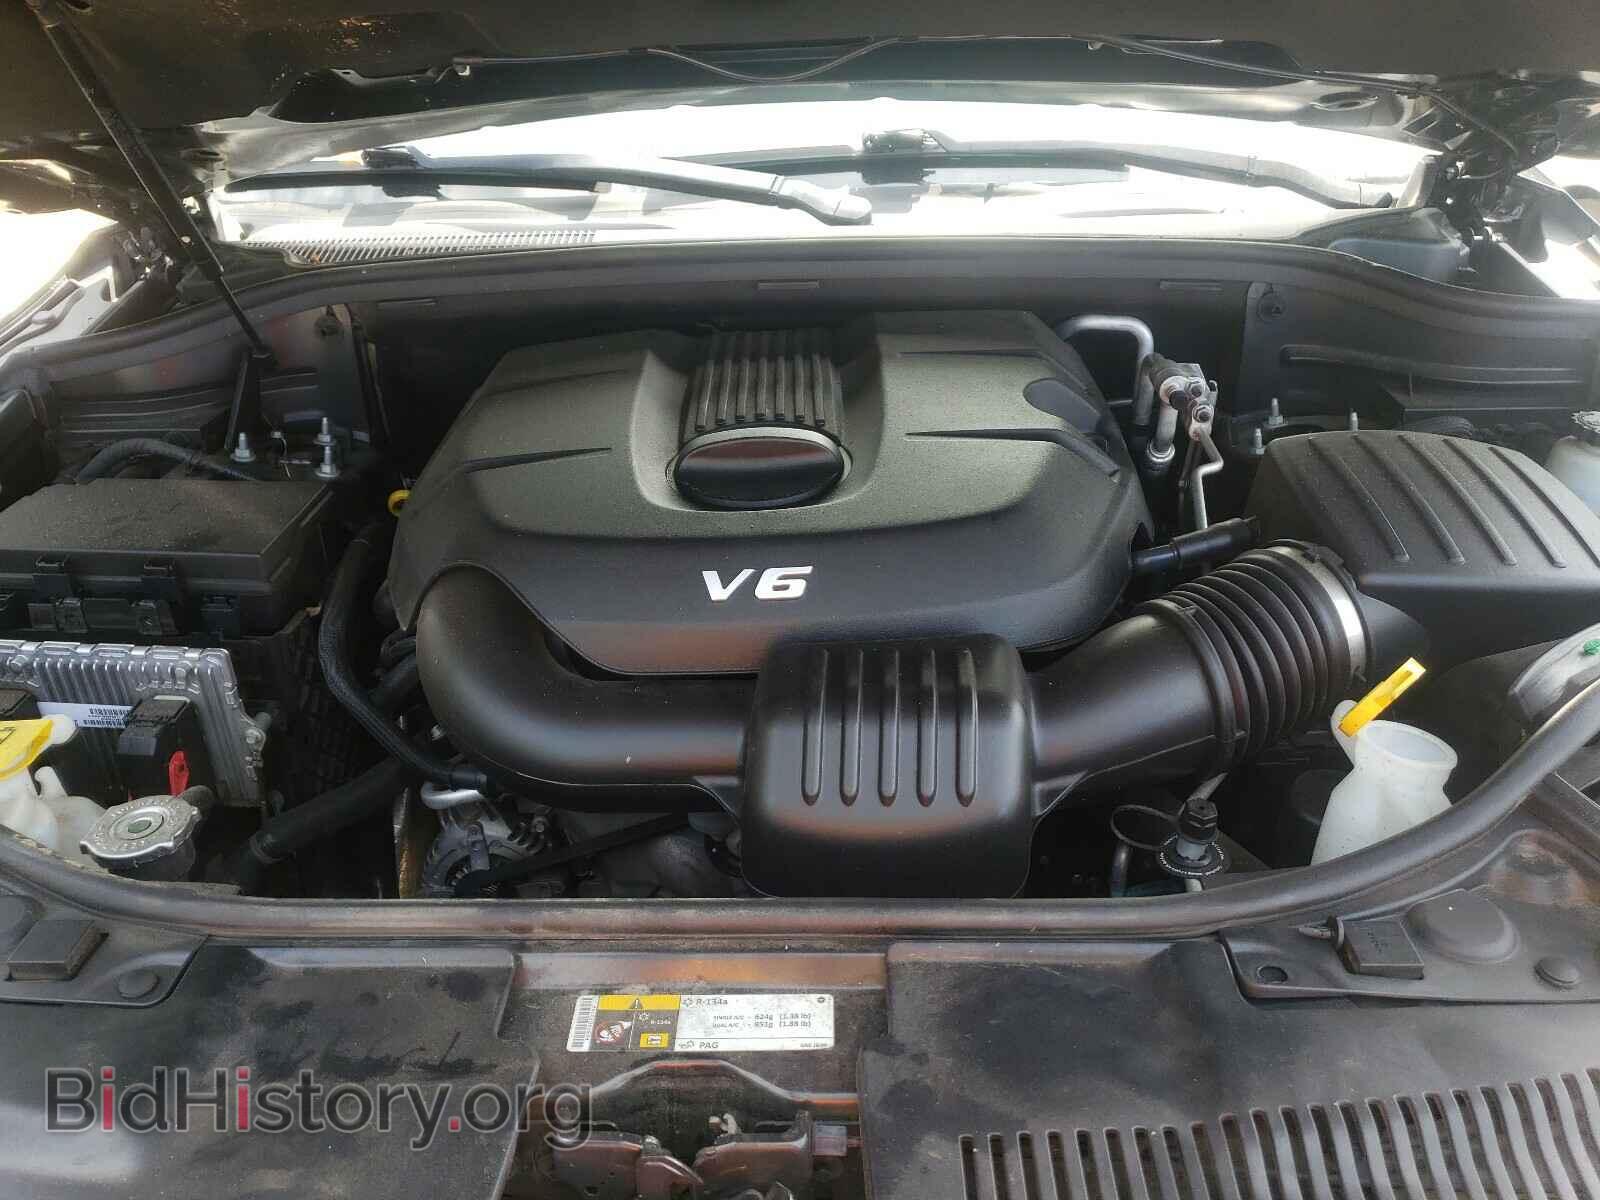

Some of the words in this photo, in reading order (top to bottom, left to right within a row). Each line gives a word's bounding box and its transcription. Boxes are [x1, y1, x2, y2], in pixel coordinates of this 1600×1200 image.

[701, 565, 814, 602] V6
[696, 998, 729, 1006] R-134a
[698, 1041, 719, 1049] PAG
